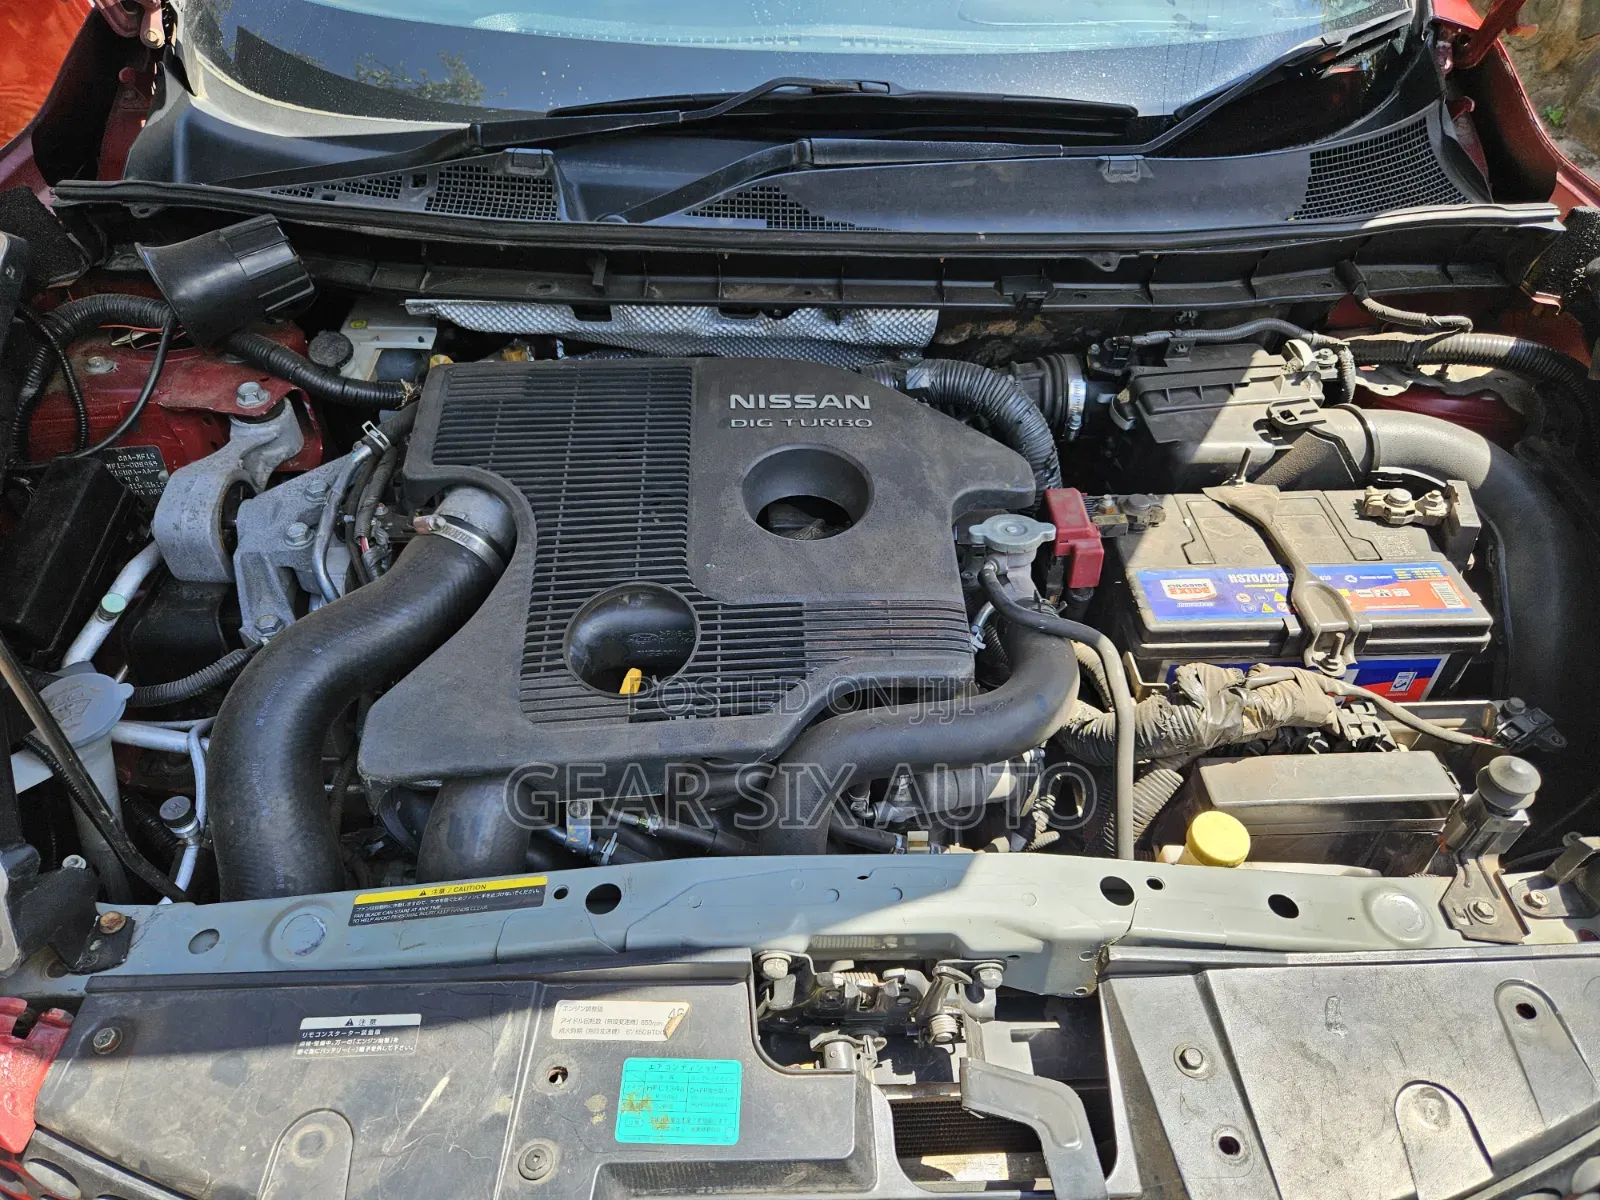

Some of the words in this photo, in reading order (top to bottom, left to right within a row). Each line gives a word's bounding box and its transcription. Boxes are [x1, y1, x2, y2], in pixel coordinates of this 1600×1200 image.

[729, 394, 871, 409] NISSAN
[731, 418, 773, 428] DIG
[780, 418, 873, 428] TURBO
[1169, 587, 1211, 595] EXIDE
[453, 884, 487, 893] CAUTION
